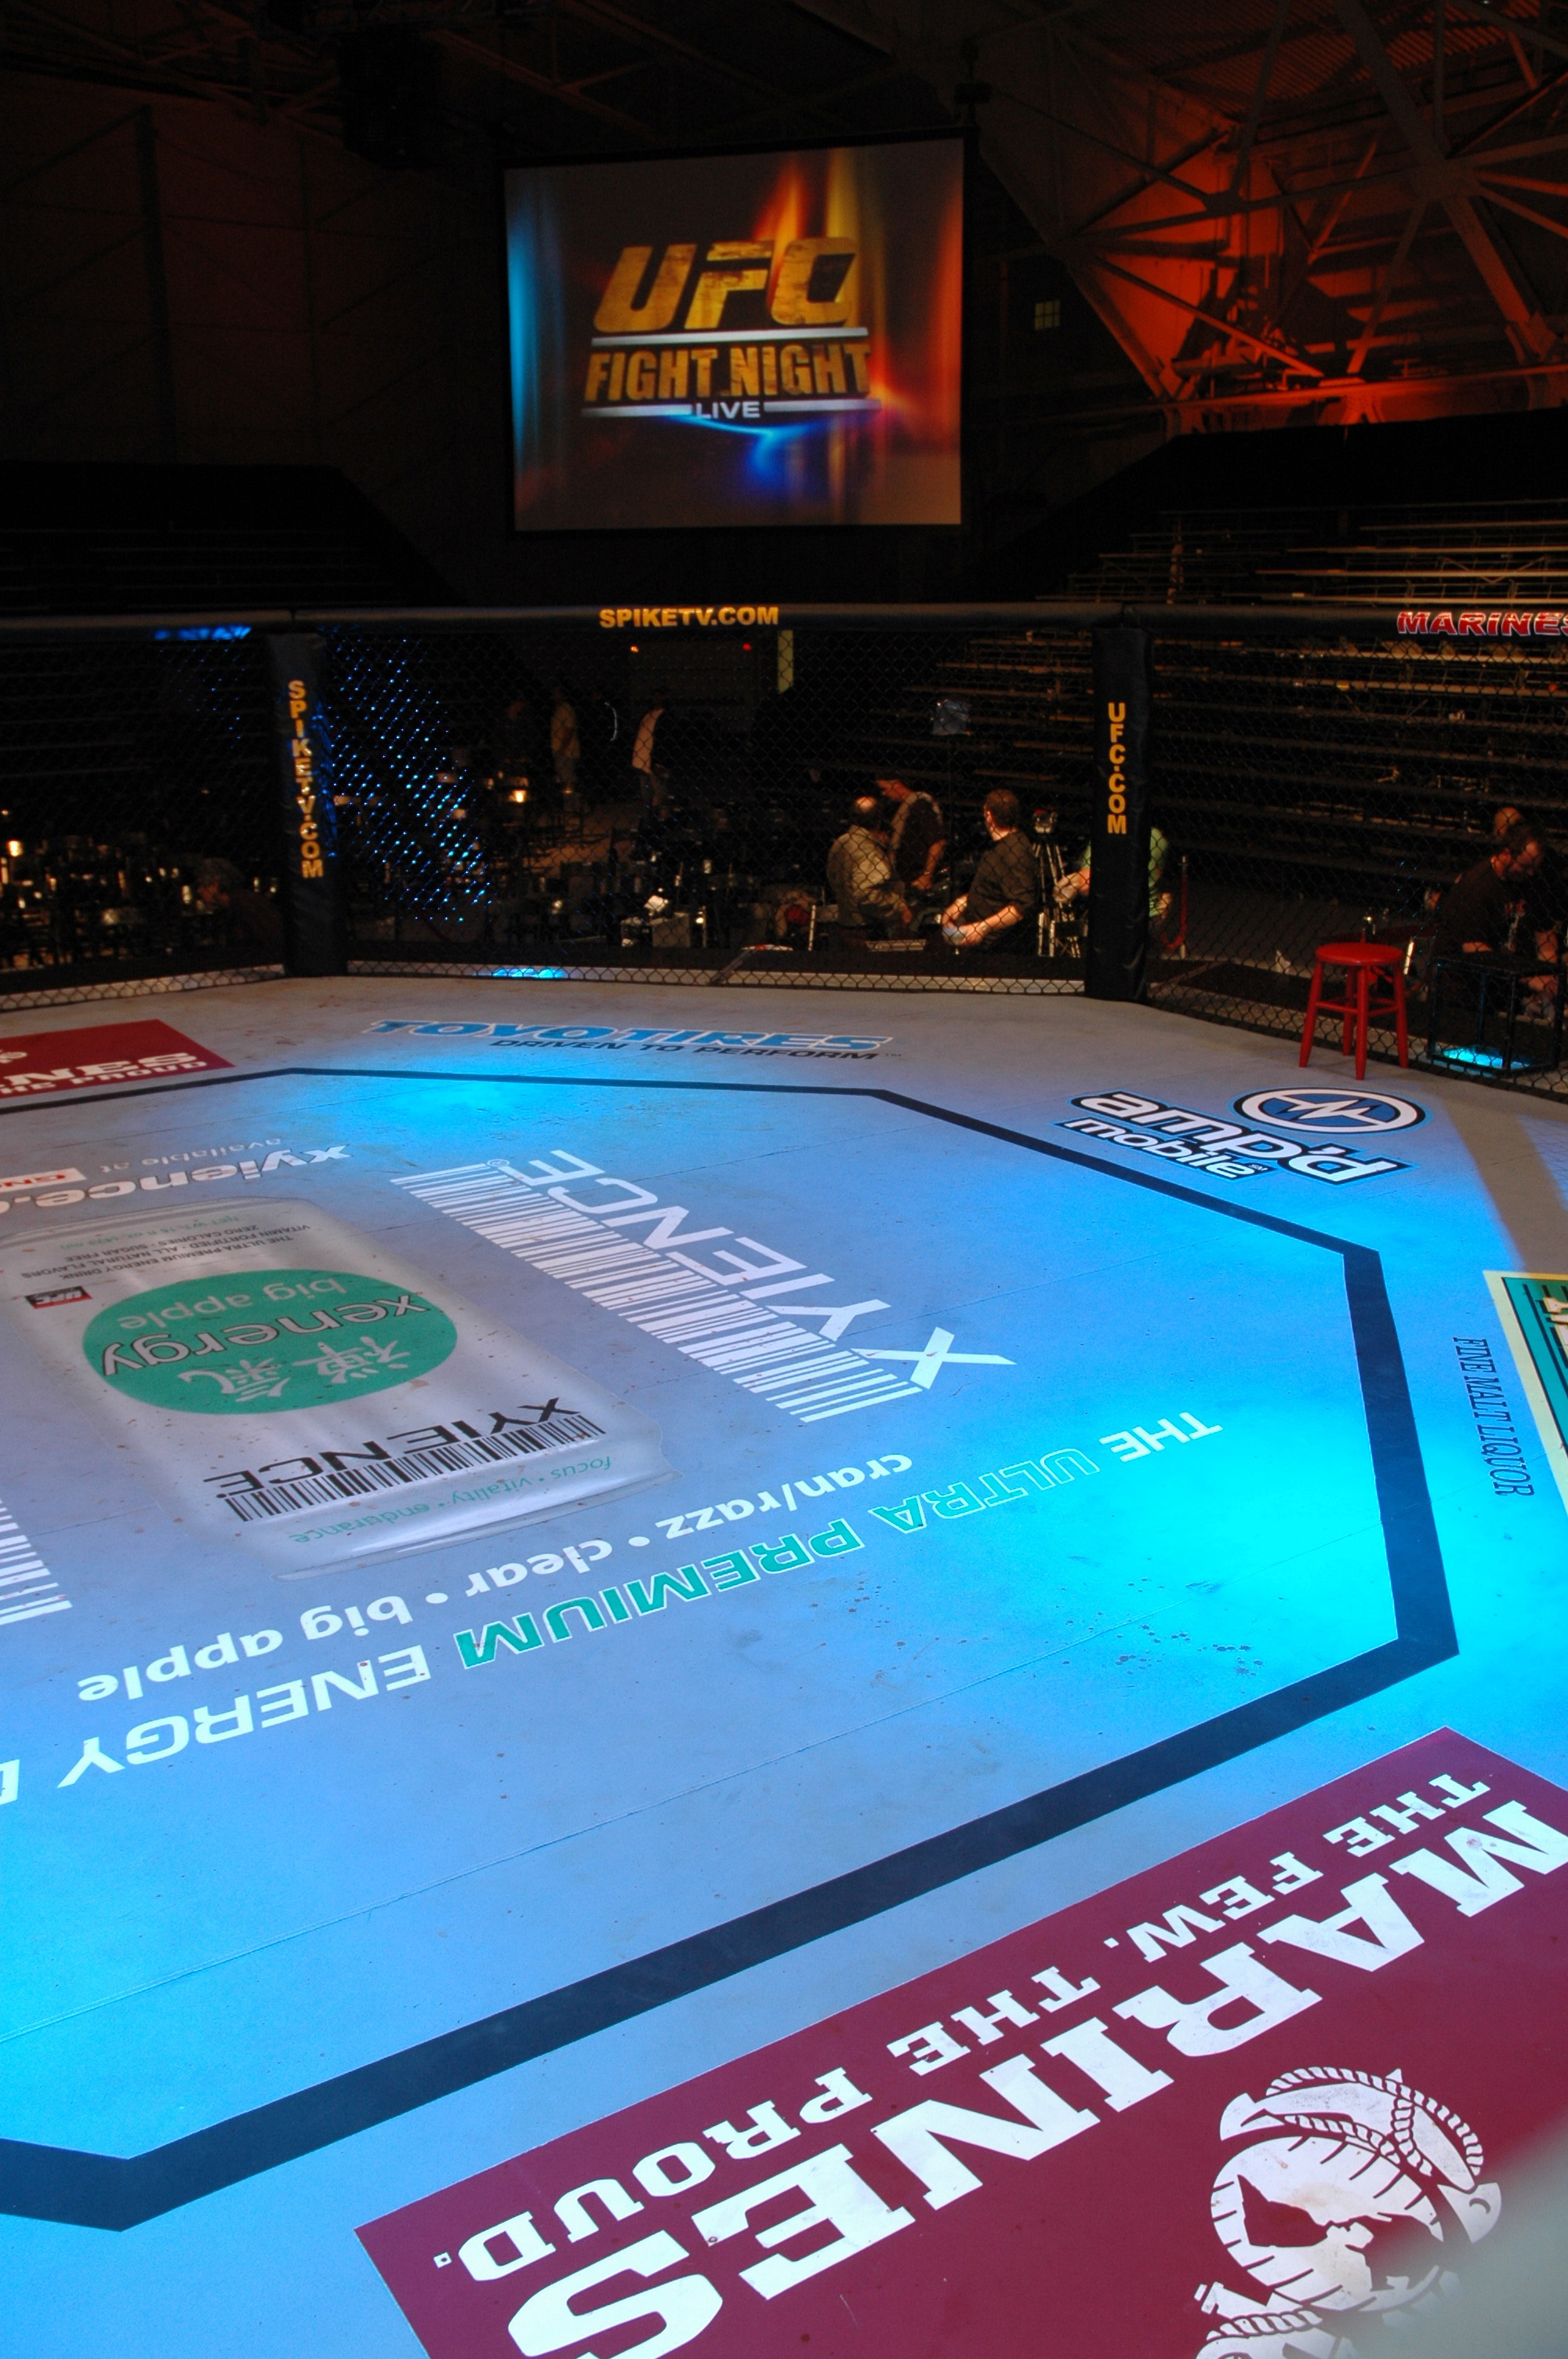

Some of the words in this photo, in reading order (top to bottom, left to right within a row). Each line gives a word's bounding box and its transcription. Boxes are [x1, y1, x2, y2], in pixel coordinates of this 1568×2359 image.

[593, 236, 860, 333] UFC
[583, 347, 719, 402] FIGHT
[730, 342, 872, 397] NIGHT
[695, 401, 762, 420] LIVE
[598, 606, 779, 629] SPIKETV.COM
[1397, 611, 1568, 637] MARINE
[288, 679, 324, 878] SPIKETV.COM
[1107, 702, 1127, 834] UFC.COM
[489, 1039, 630, 1049] DRIVEN
[642, 1044, 684, 1052] TO
[694, 1046, 879, 1060] PERFORM
[100, 1161, 130, 1173] at
[140, 1138, 282, 1166] available
[1063, 1118, 1256, 1179] mobile
[263, 1278, 347, 1301] big
[495, 1150, 1018, 1390] XYIENCE
[100, 1294, 431, 1377] xenergy
[117, 1294, 255, 1329] apple
[1452, 1336, 1497, 1374] FINE
[1464, 1375, 1512, 1422] MALT
[203, 1397, 582, 1499] XYIENCE
[551, 1455, 613, 1480] focus
[1099, 1411, 1223, 1463] THE
[1477, 1423, 1535, 1497] LIQUOR
[450, 1476, 533, 1505] vitality
[655, 1452, 913, 1542] cran/razz
[869, 1447, 1102, 1534] ULTRA
[288, 1502, 431, 1544] endurance
[453, 1517, 866, 1670] PREMIUM
[464, 1537, 614, 1598] clear
[299, 1594, 414, 1641] big
[77, 1625, 284, 1702] apple
[57, 1644, 432, 1789] ENERGY
[1323, 1772, 1492, 1858] THE
[1103, 1850, 1325, 1964] FEW.
[886, 1965, 1102, 2077] THE
[507, 1799, 1568, 2359] MARINES
[433, 2066, 873, 2283] PROUD.
